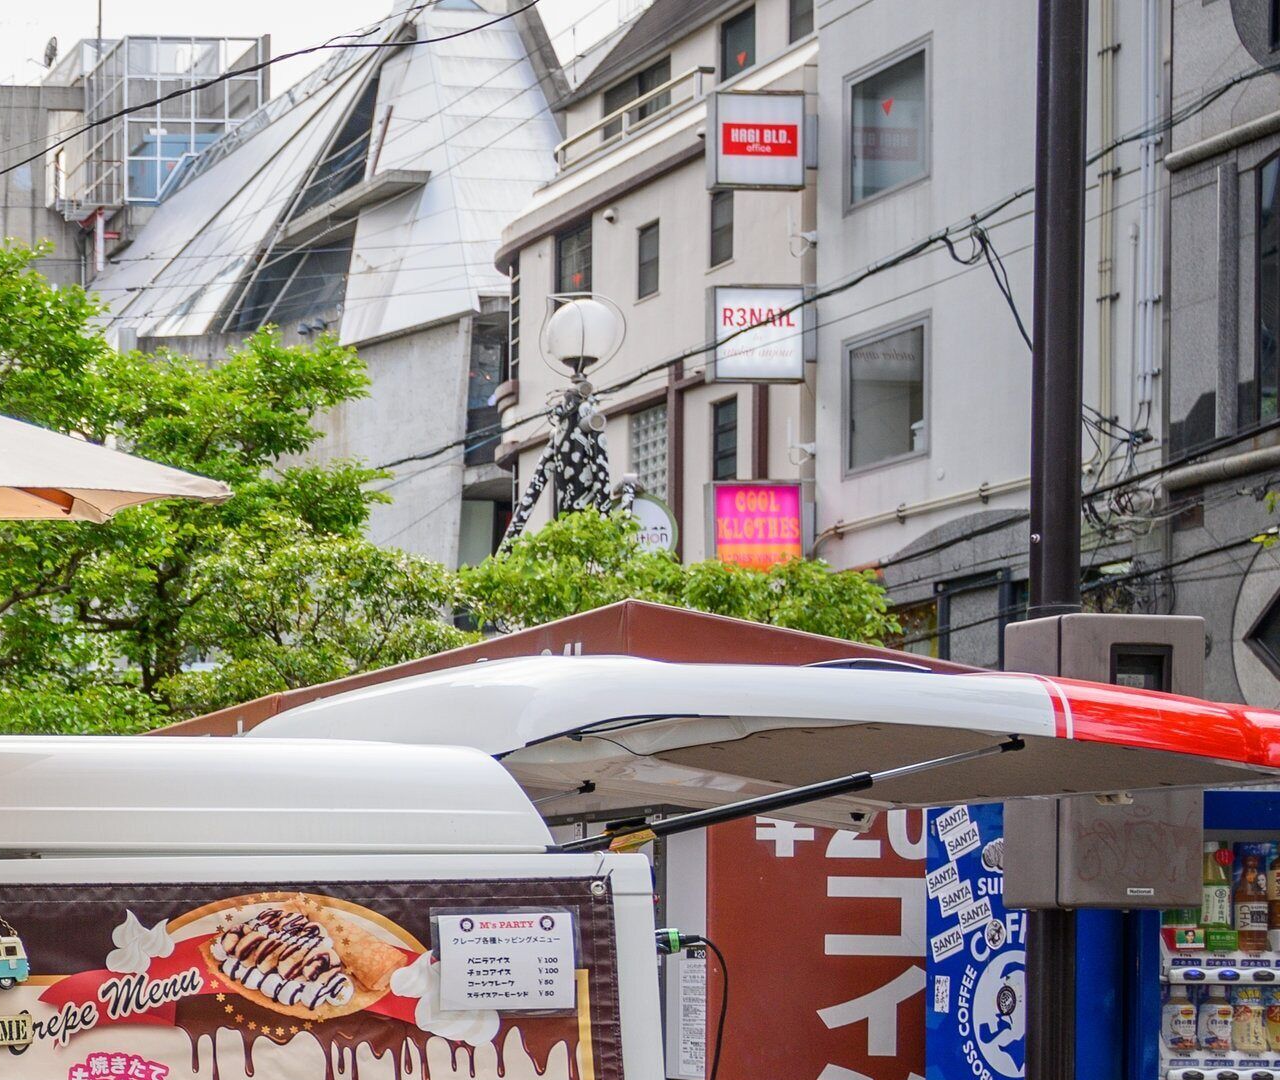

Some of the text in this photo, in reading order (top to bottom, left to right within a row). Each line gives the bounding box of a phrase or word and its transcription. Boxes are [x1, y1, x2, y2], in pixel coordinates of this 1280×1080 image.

[763, 129, 791, 143] BLD.
[746, 144, 772, 153] office
[735, 490, 781, 512] COOL
[717, 516, 799, 539] KLOTHES
[938, 807, 968, 833] SANTA
[947, 827, 978, 853] SANTA
[928, 866, 958, 890] SANTA
[941, 885, 972, 909] SANTA
[960, 902, 991, 925] SANTA
[933, 930, 962, 953] SANTA
[102, 969, 200, 1017] Menu
[957, 964, 977, 1037] COFFEE
